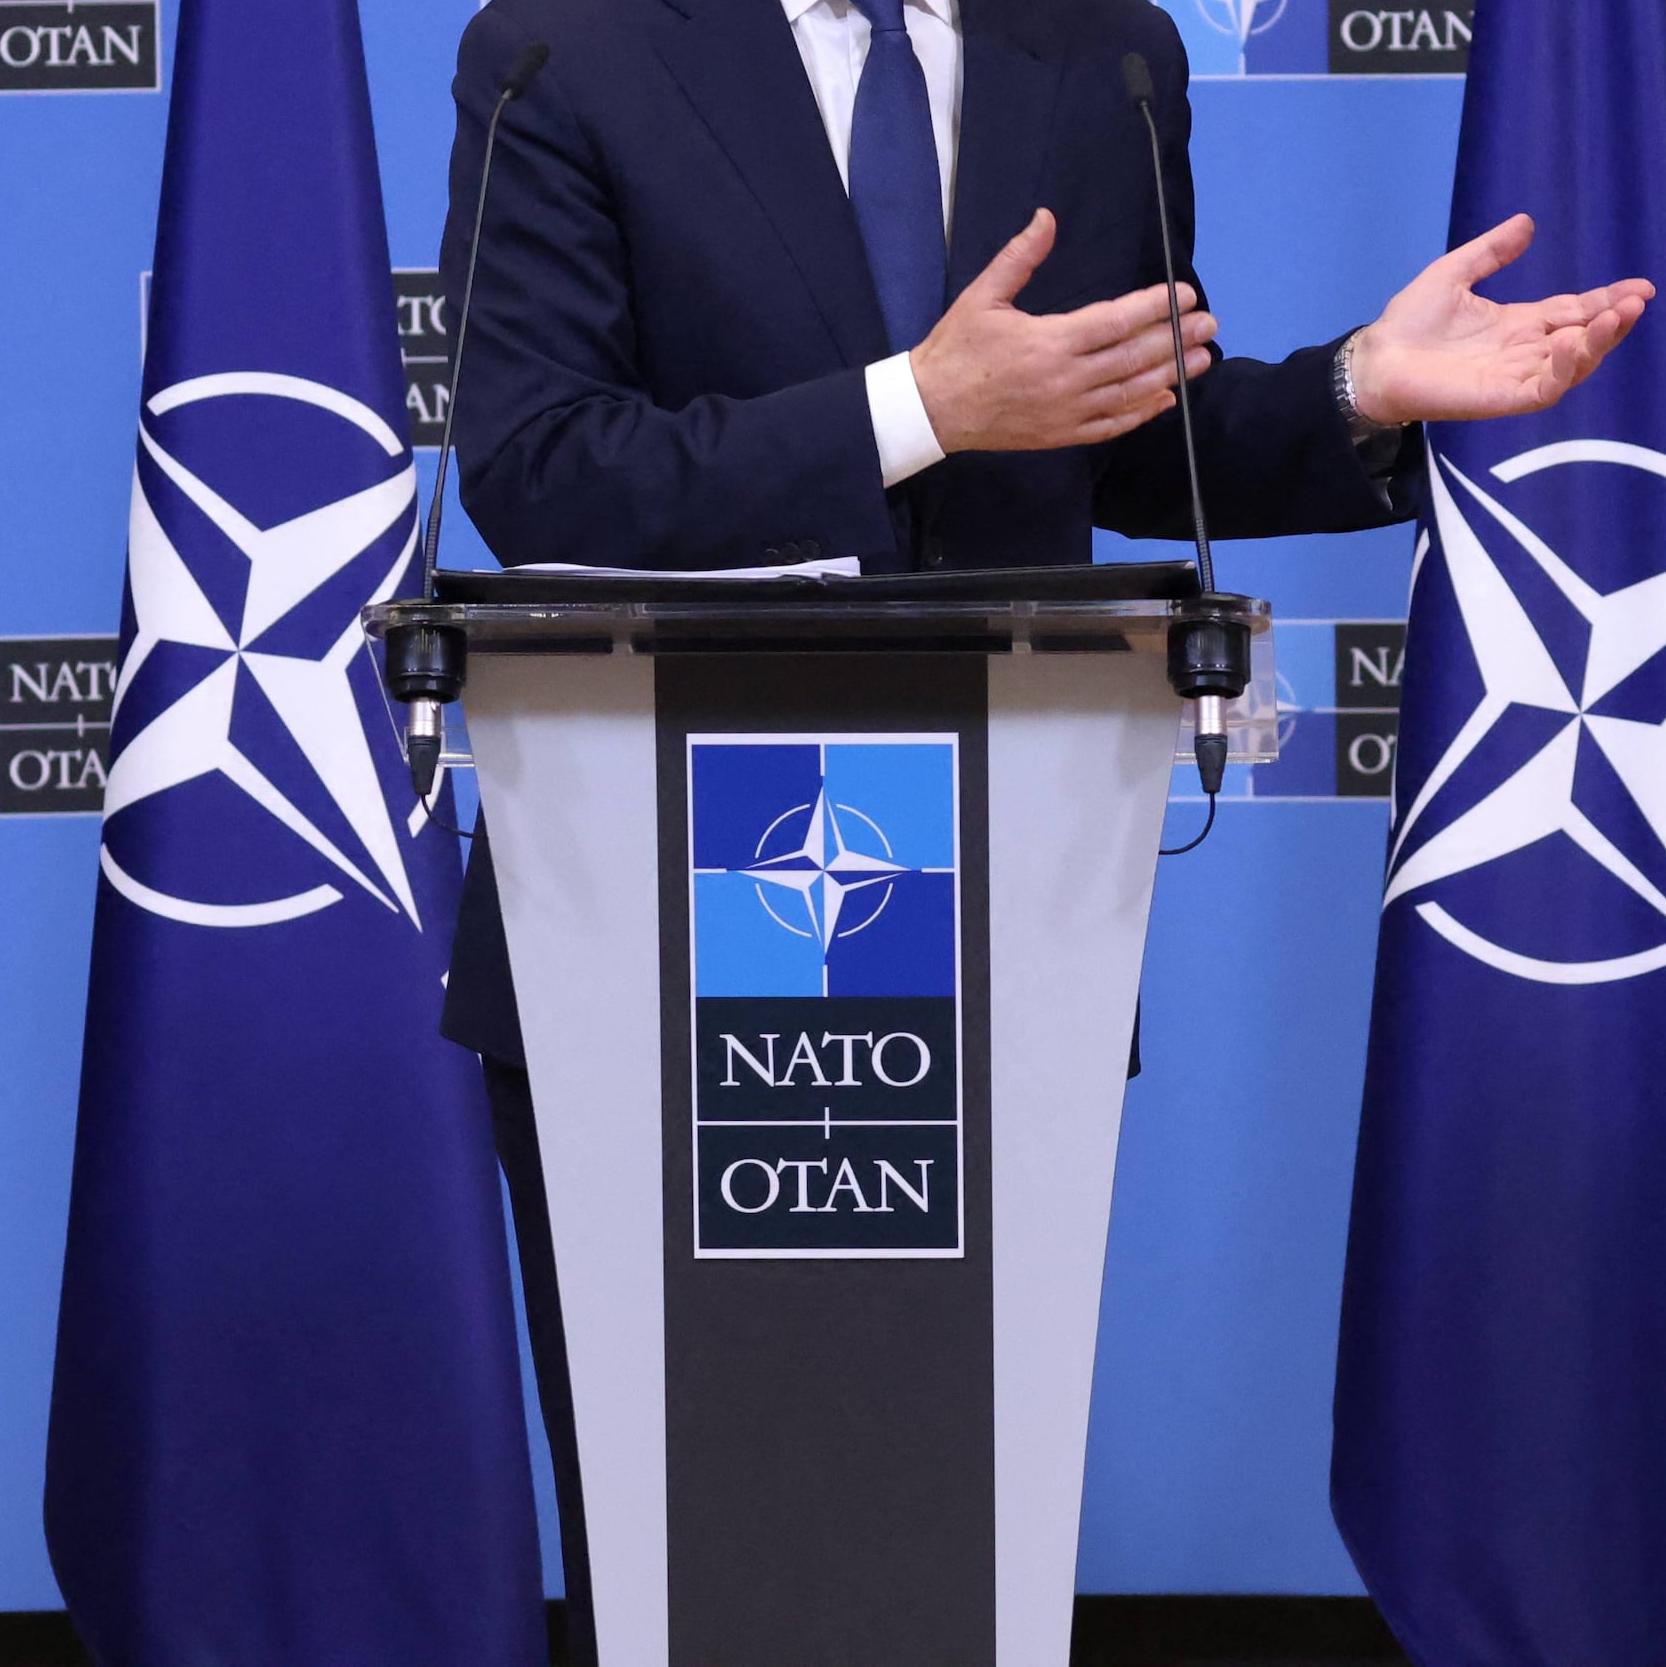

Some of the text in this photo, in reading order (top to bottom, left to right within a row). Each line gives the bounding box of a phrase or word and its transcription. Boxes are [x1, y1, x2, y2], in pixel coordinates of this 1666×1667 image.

[9, 661, 117, 703] NAT
[9, 748, 108, 791] OTA
[719, 1031, 931, 1087] NATO
[720, 1157, 934, 1213] OTAN
